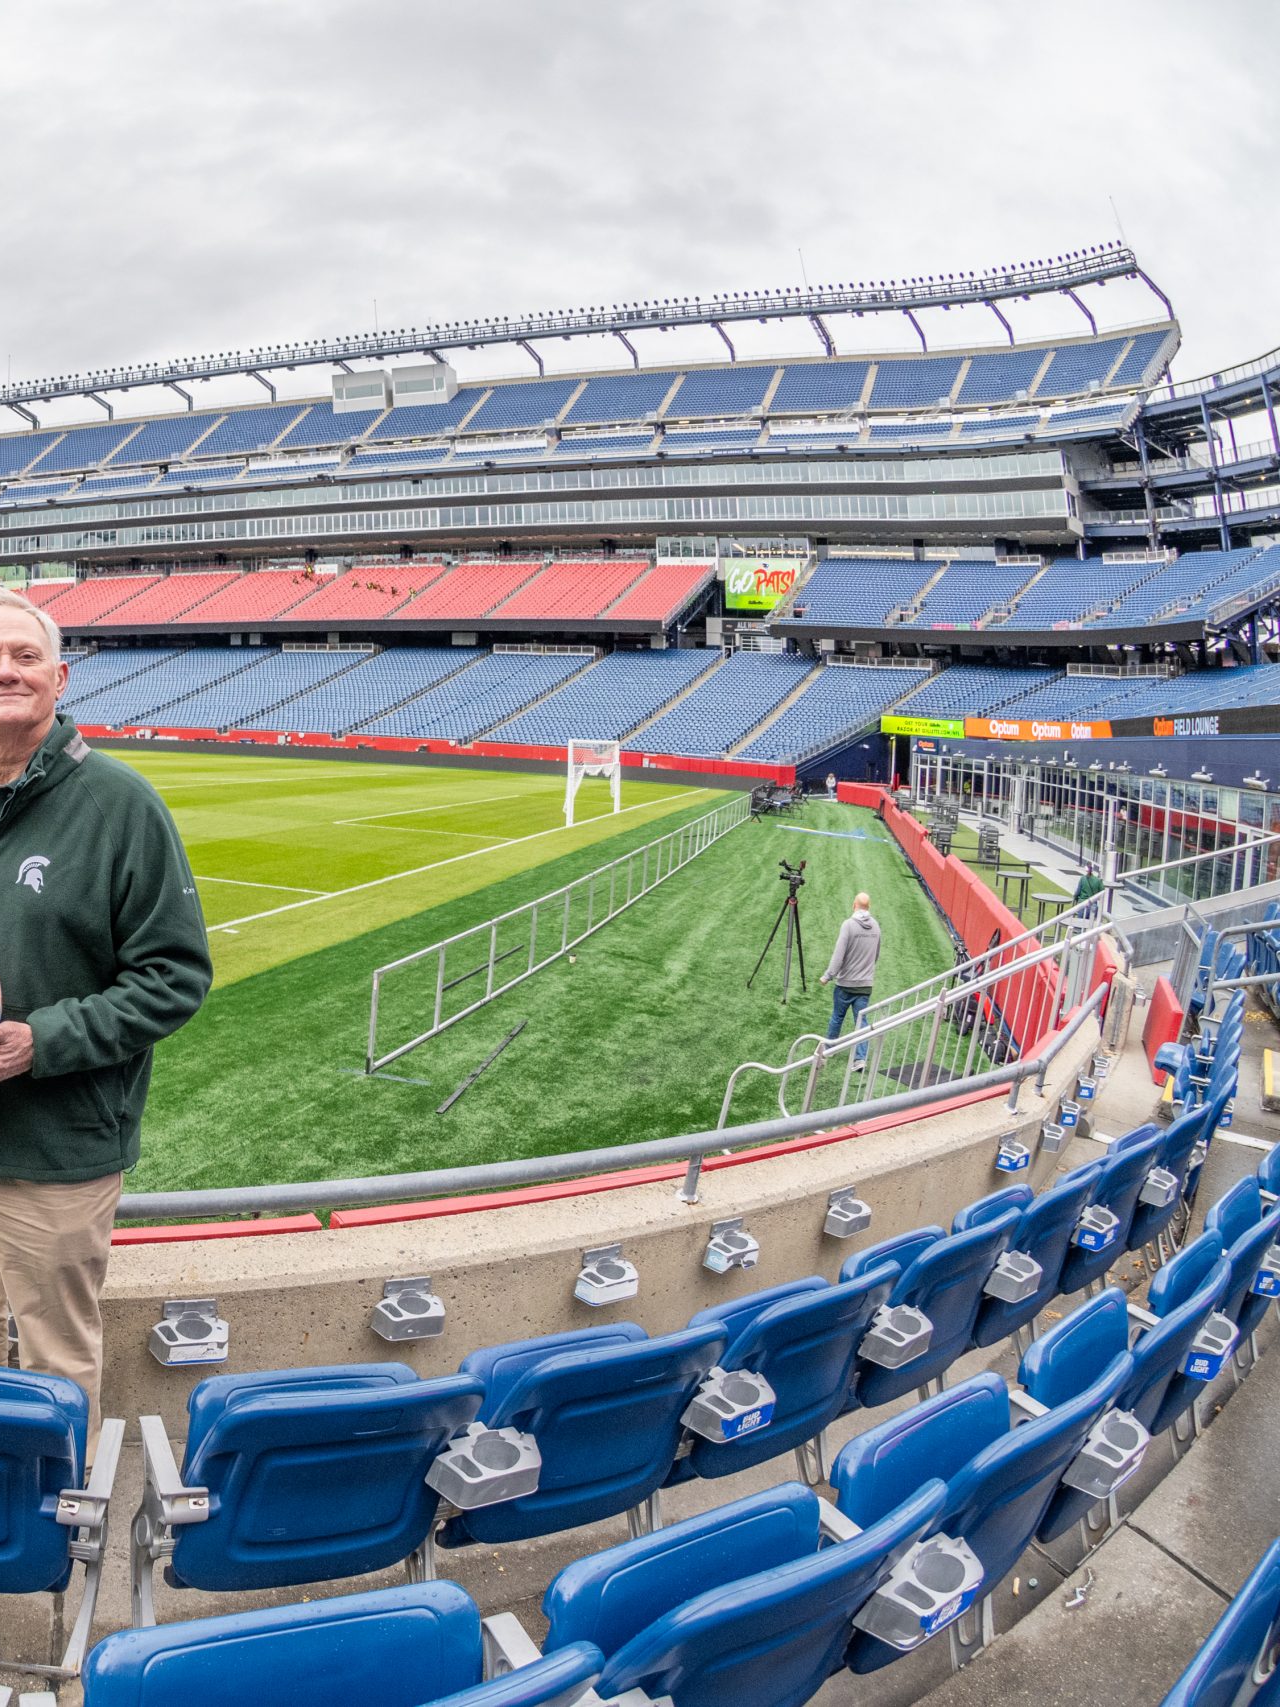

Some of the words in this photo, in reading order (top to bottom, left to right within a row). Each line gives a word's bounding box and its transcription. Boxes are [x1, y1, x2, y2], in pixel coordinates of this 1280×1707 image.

[728, 568, 754, 594] GO
[754, 568, 796, 595] PATS!
[989, 720, 1020, 738] Optum
[1031, 721, 1061, 740] Optum
[1070, 722, 1092, 739] Optum
[1174, 718, 1191, 735] FIELD
[1191, 715, 1219, 735] LOUNGE
[1190, 1365, 1210, 1374] LIGHT
[1194, 1359, 1209, 1367] BUD
[736, 1416, 762, 1432] LIGHT
[742, 1410, 761, 1424] BUD
